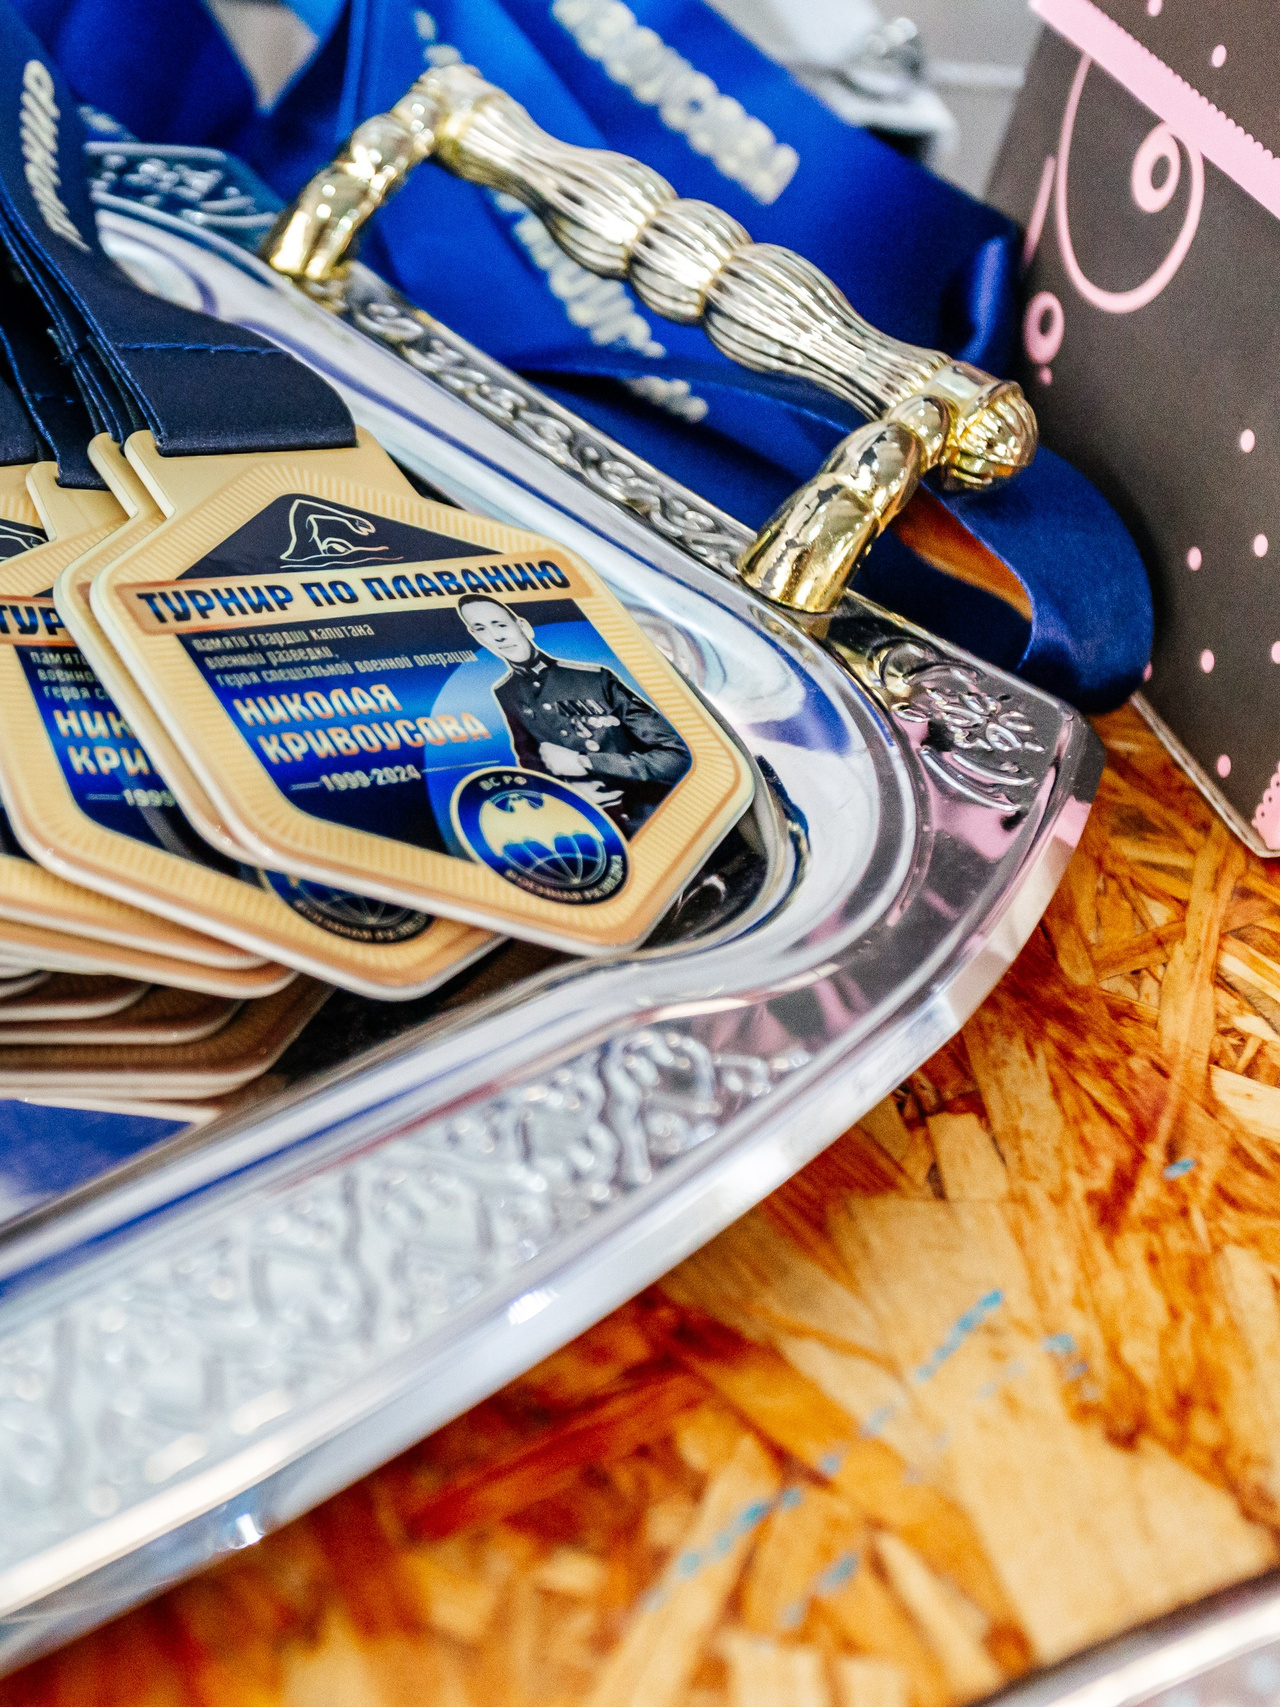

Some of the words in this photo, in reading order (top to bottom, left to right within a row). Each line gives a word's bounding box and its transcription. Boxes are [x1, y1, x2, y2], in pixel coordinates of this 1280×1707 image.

[136, 584, 294, 624] ТУРНИР
[300, 580, 360, 607] ПО
[361, 560, 571, 600] ПЛАВАНИЮ
[309, 623, 375, 641] капитана
[354, 654, 414, 674] военной
[413, 650, 479, 668] операции
[233, 684, 403, 726] НИКОЛАЯ
[257, 712, 492, 765] КРИВОУСОВА
